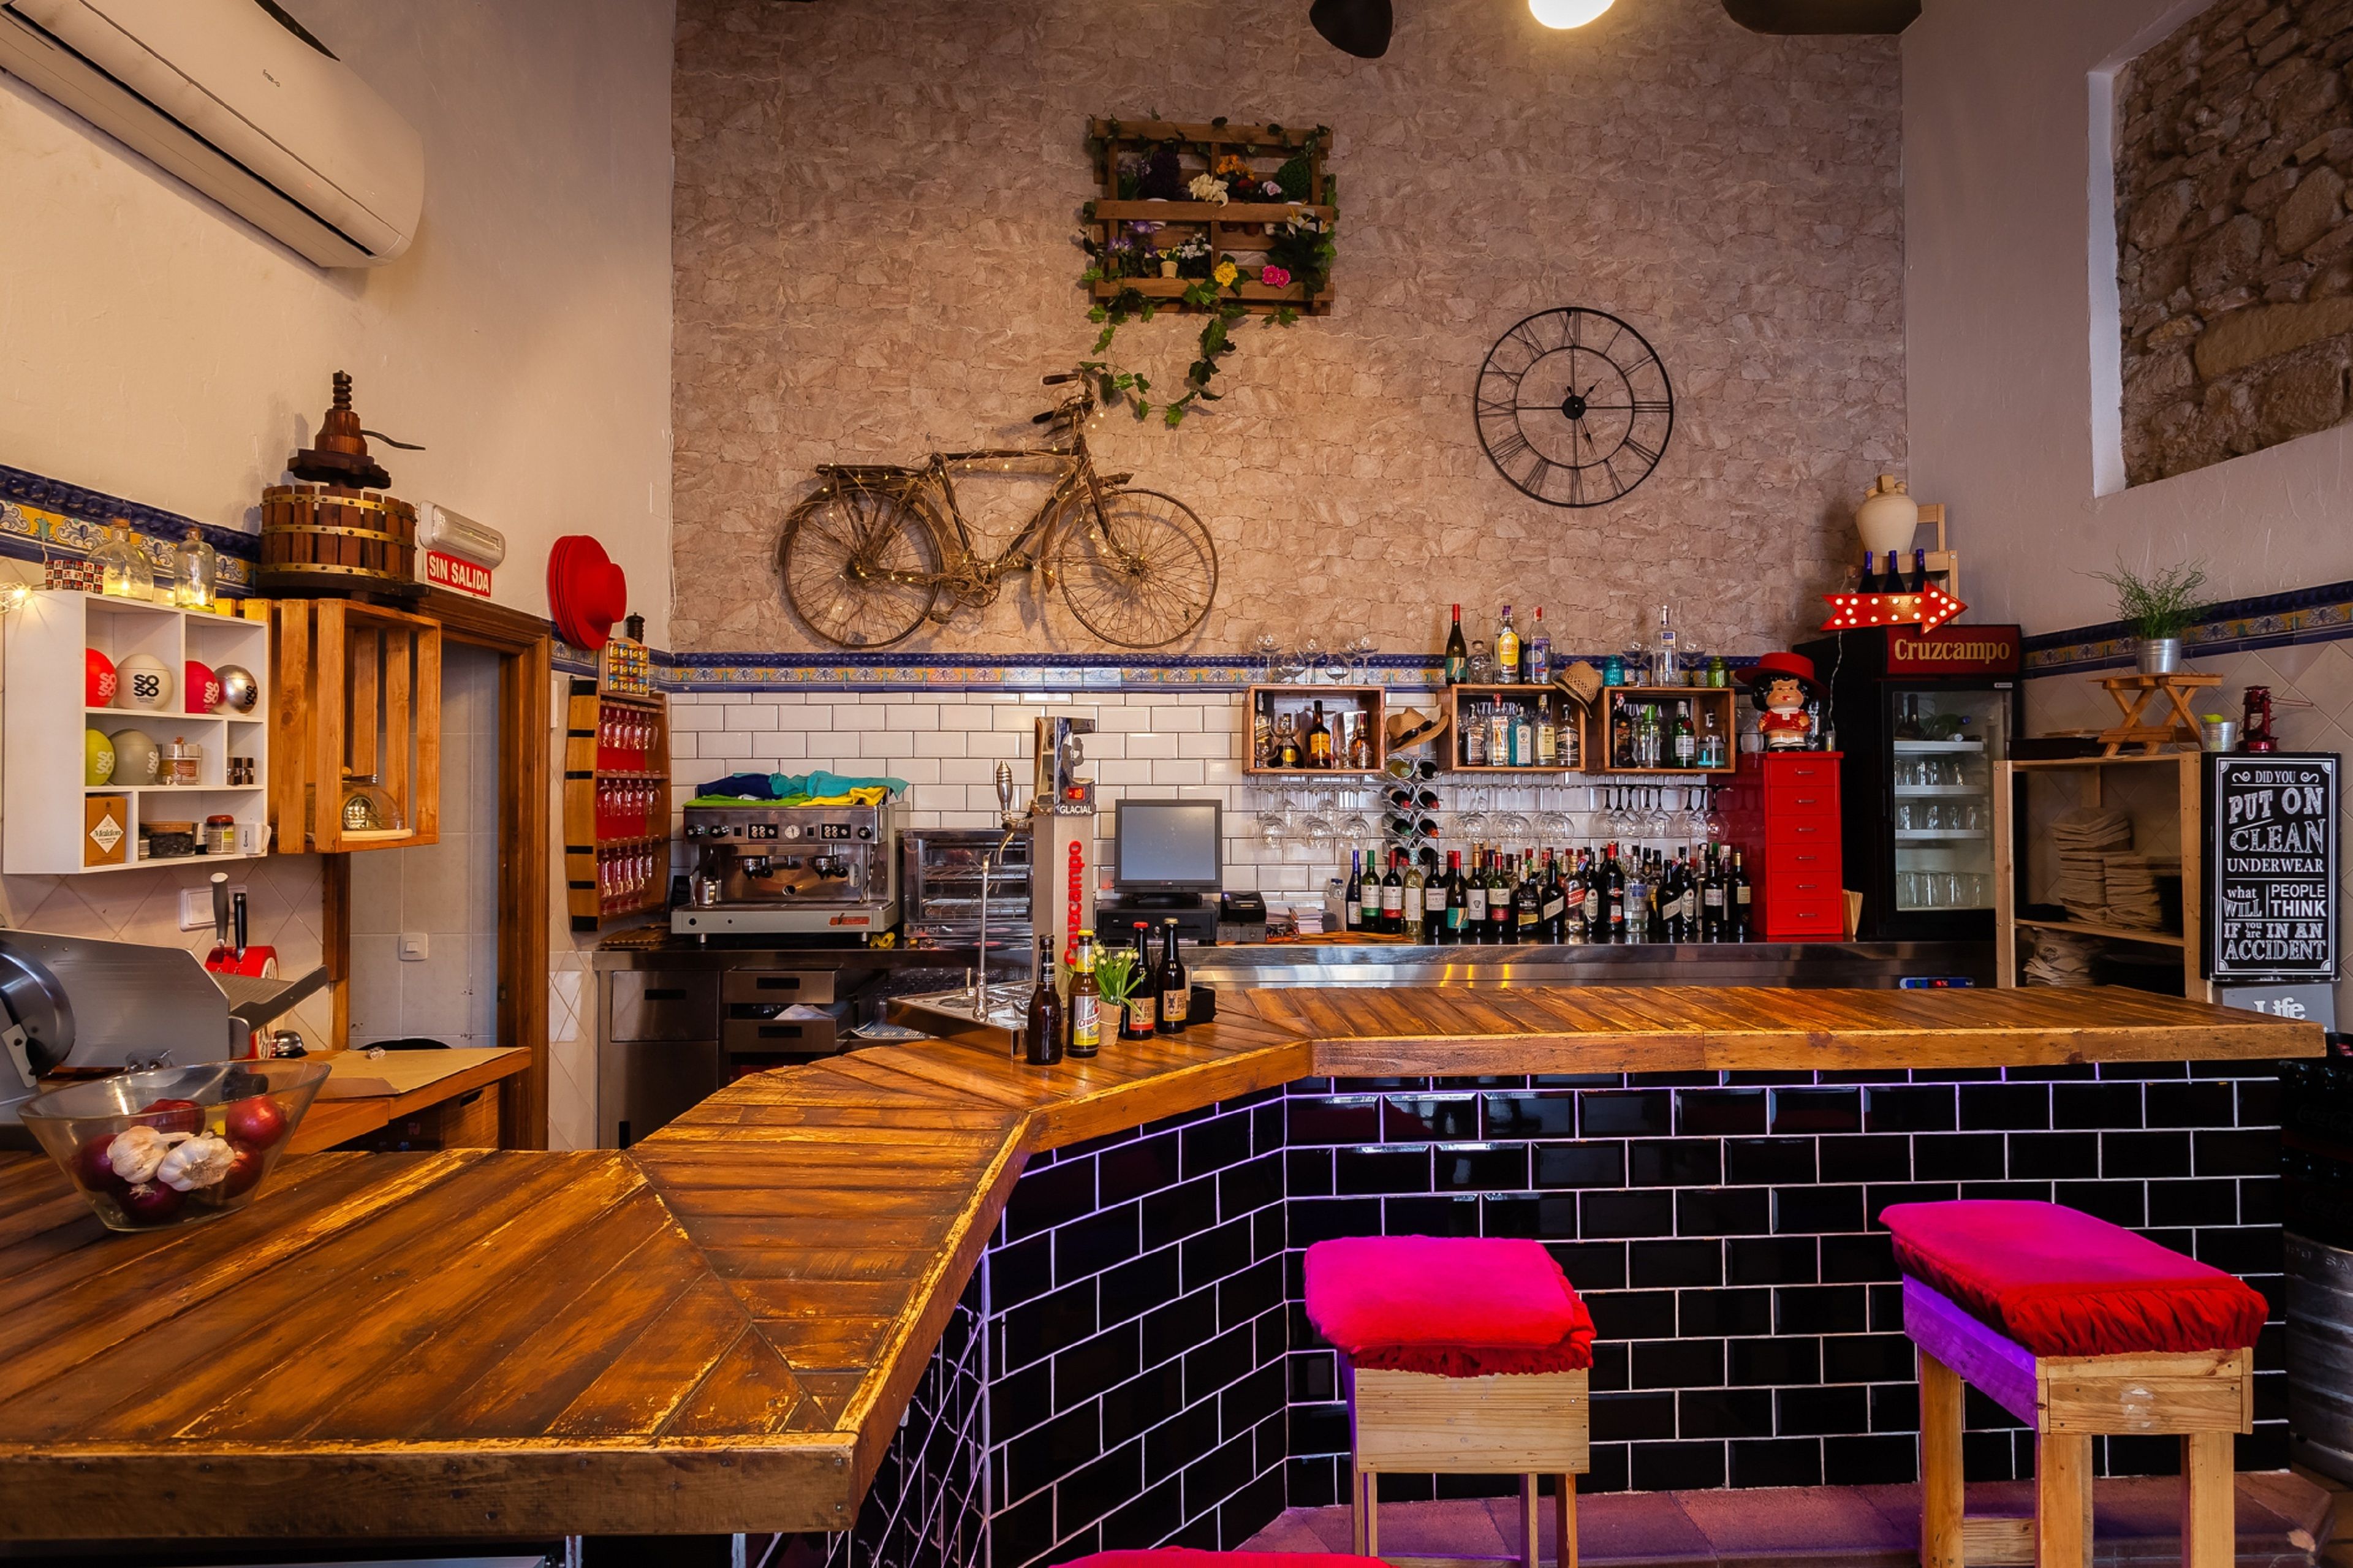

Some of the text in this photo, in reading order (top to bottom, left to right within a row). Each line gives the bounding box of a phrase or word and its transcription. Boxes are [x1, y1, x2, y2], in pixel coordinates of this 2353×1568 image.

[429, 555, 489, 593] SIN SALIDA
[1895, 638, 2010, 664] Cruzcampo
[134, 675, 159, 686] SO
[134, 687, 159, 697] SO
[2255, 771, 2295, 783] DID YOU
[1059, 805, 1093, 814] GLACIAL
[2229, 787, 2324, 824] PUT ON
[2230, 819, 2326, 854] CLEAN
[2226, 858, 2324, 873] UNDERWEAR
[2227, 884, 2325, 899] what PEOPLE
[2222, 896, 2327, 918] WILL THINK
[2224, 921, 2322, 939] IF you are IN AN
[2224, 939, 2326, 961] ACCIDENT
[2254, 997, 2305, 1020] Life
